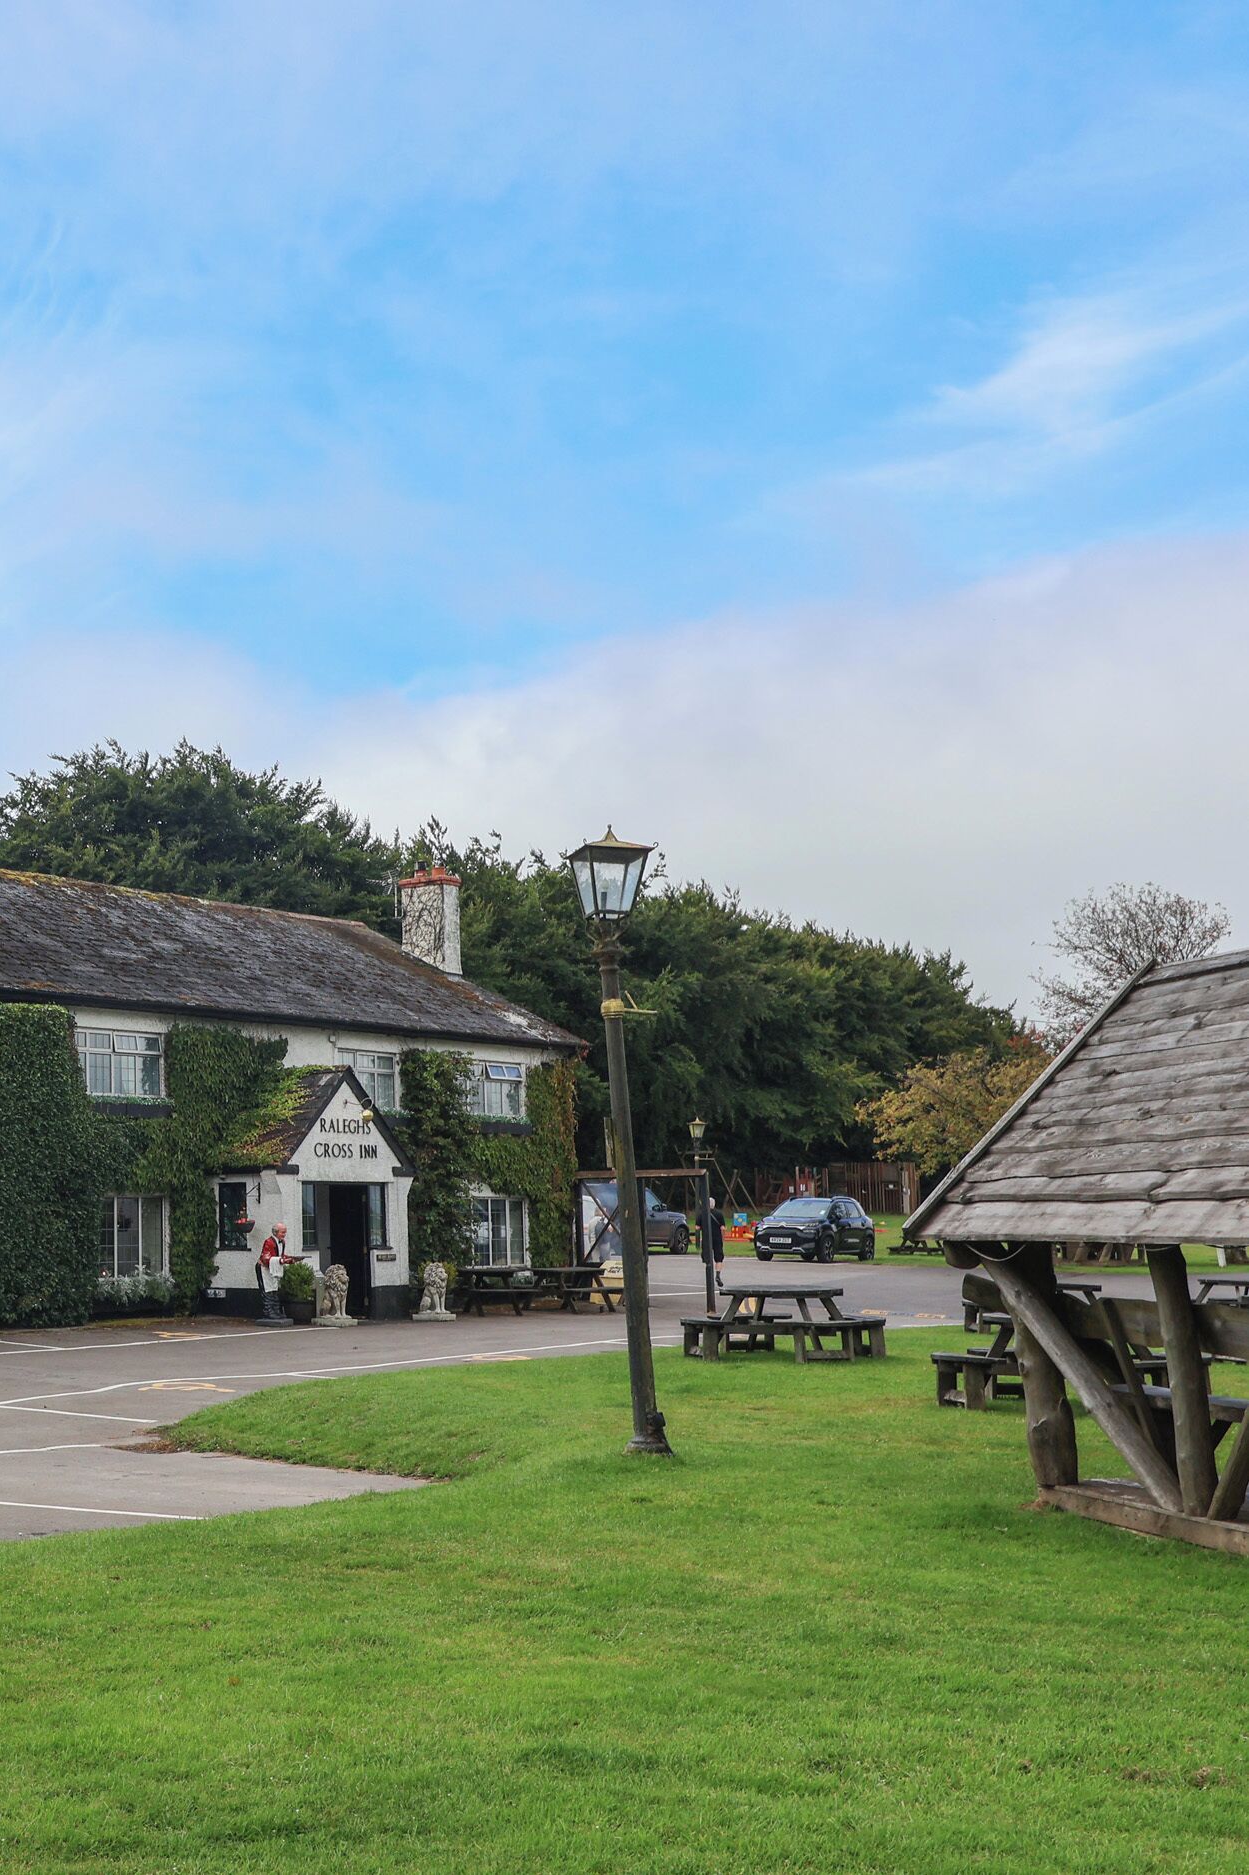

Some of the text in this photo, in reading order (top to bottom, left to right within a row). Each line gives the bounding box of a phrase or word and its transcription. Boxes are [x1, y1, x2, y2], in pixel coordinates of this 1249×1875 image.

[319, 1118, 371, 1135] RALEGHS
[314, 1142, 377, 1159] CROSS INN
